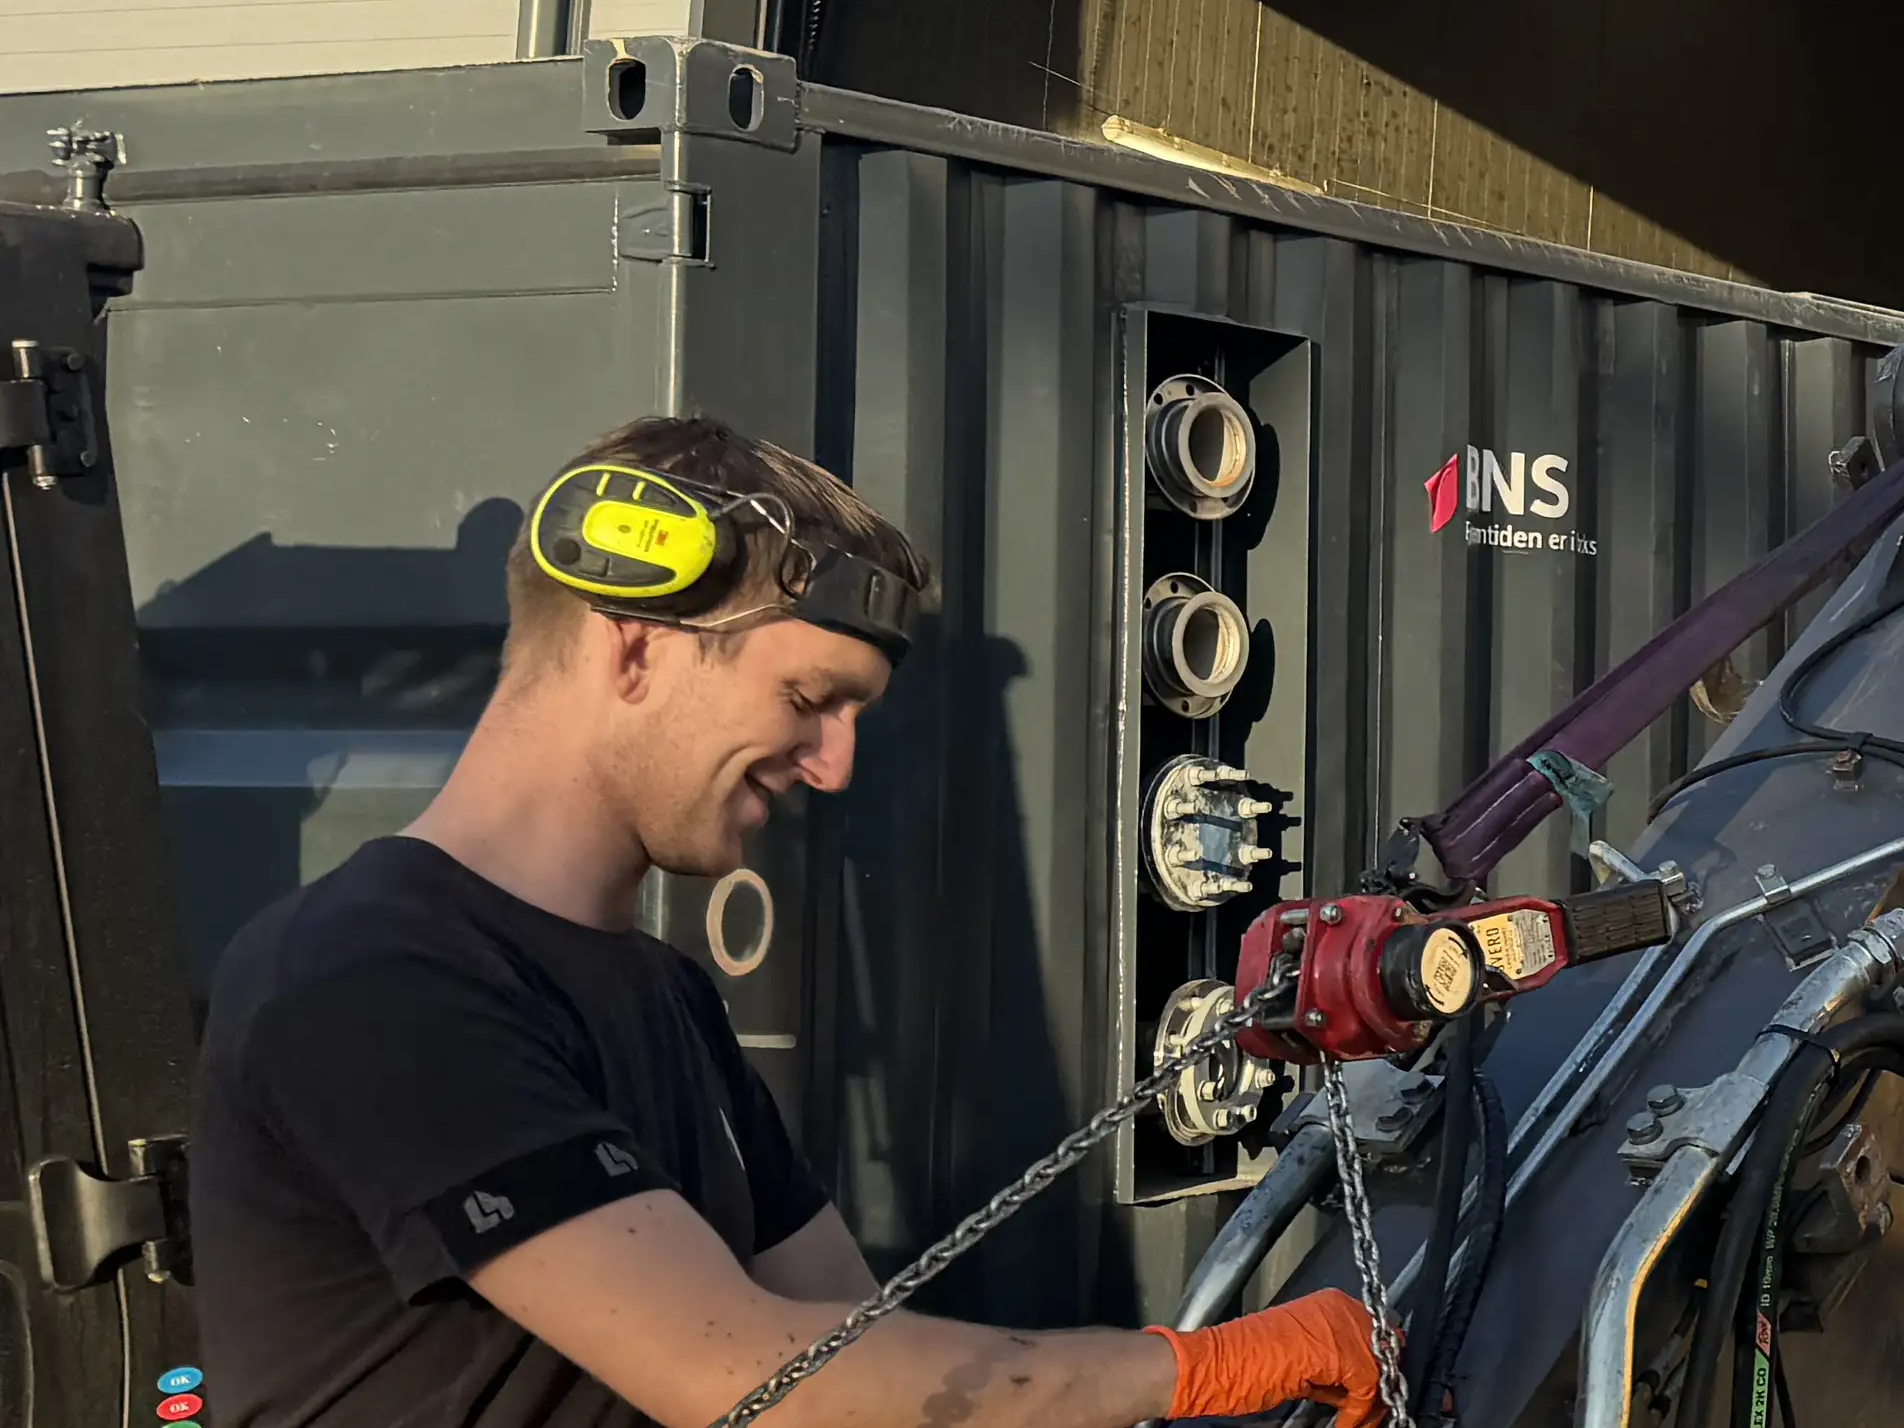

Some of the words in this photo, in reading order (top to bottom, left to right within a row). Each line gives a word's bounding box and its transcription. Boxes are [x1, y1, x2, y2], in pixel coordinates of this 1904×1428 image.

[1466, 444, 1570, 519] BNS
[1548, 533, 1567, 551] er
[1760, 1292, 1771, 1307] ID
[170, 1375, 191, 1386] OK
[169, 1402, 189, 1413] OK
